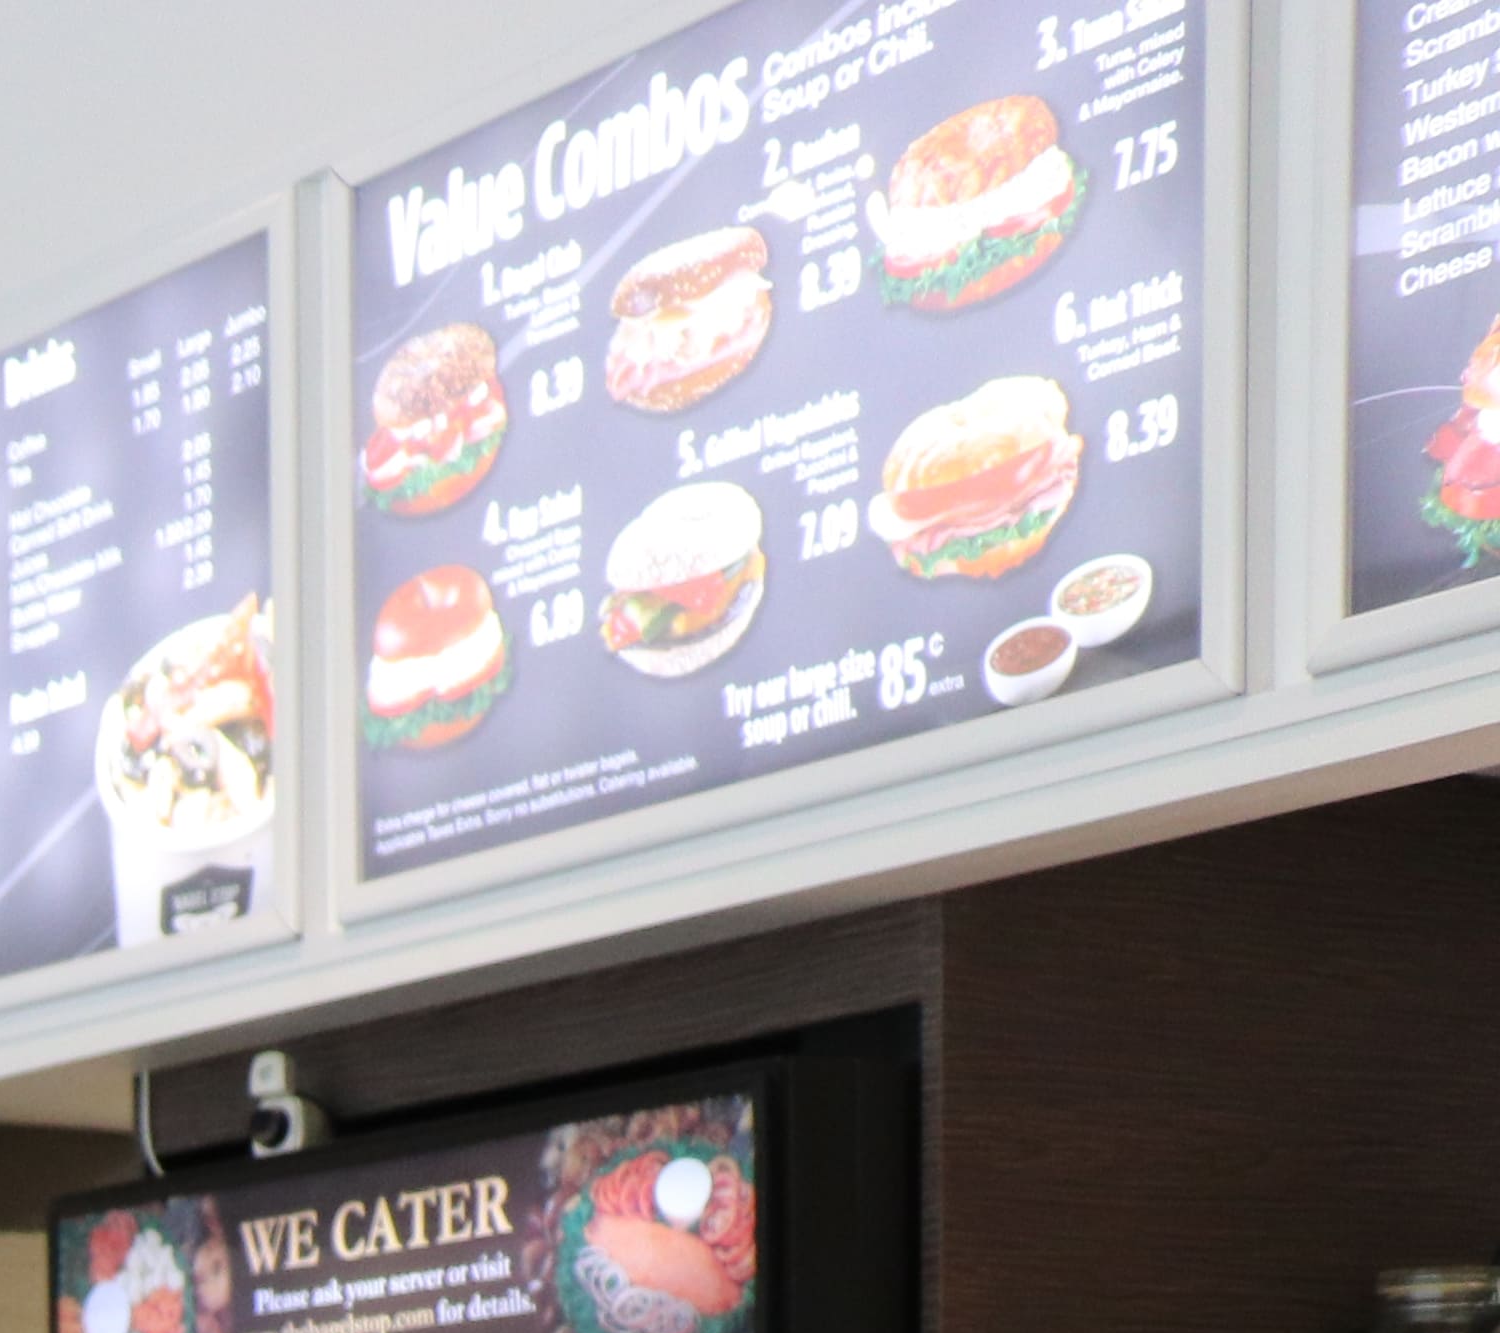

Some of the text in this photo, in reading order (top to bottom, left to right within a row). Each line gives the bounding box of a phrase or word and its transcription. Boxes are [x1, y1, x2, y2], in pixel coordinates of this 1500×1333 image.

[763, 18, 873, 88] Combos
[1036, 15, 1068, 71] 3.
[1138, 20, 1186, 54] mixed
[763, 21, 934, 122] Soup or Chili.
[1102, 45, 1186, 92] with Celery
[1403, 57, 1490, 107] Turkey
[388, 162, 525, 288] Value
[536, 57, 750, 221] Combos
[764, 138, 790, 186] 2.
[1114, 119, 1179, 192] 7.75
[1400, 137, 1479, 187] Bacon
[1402, 173, 1492, 224] Lettuce
[481, 261, 501, 306] 1.
[801, 246, 862, 311] 8.39
[1399, 246, 1493, 297] Cheese
[1054, 291, 1087, 344] 6.
[1130, 270, 1183, 318] Trick
[1132, 322, 1167, 344] Ham
[230, 363, 261, 395] 2.10
[678, 429, 703, 478] 5.
[1106, 393, 1179, 462] 8.39
[483, 500, 508, 545] 4.
[799, 498, 858, 561] 7.09
[724, 682, 752, 718] Try
[755, 675, 788, 710] our
[789, 664, 837, 702] large
[838, 647, 877, 686] size
[742, 709, 788, 747] soup
[789, 701, 811, 735] or
[929, 673, 966, 698] extra
[239, 1175, 514, 1277] WE CATER
[253, 1250, 512, 1317] Please ask your server or visit
[436, 1296, 465, 1326] for
[466, 1287, 537, 1323] details.
